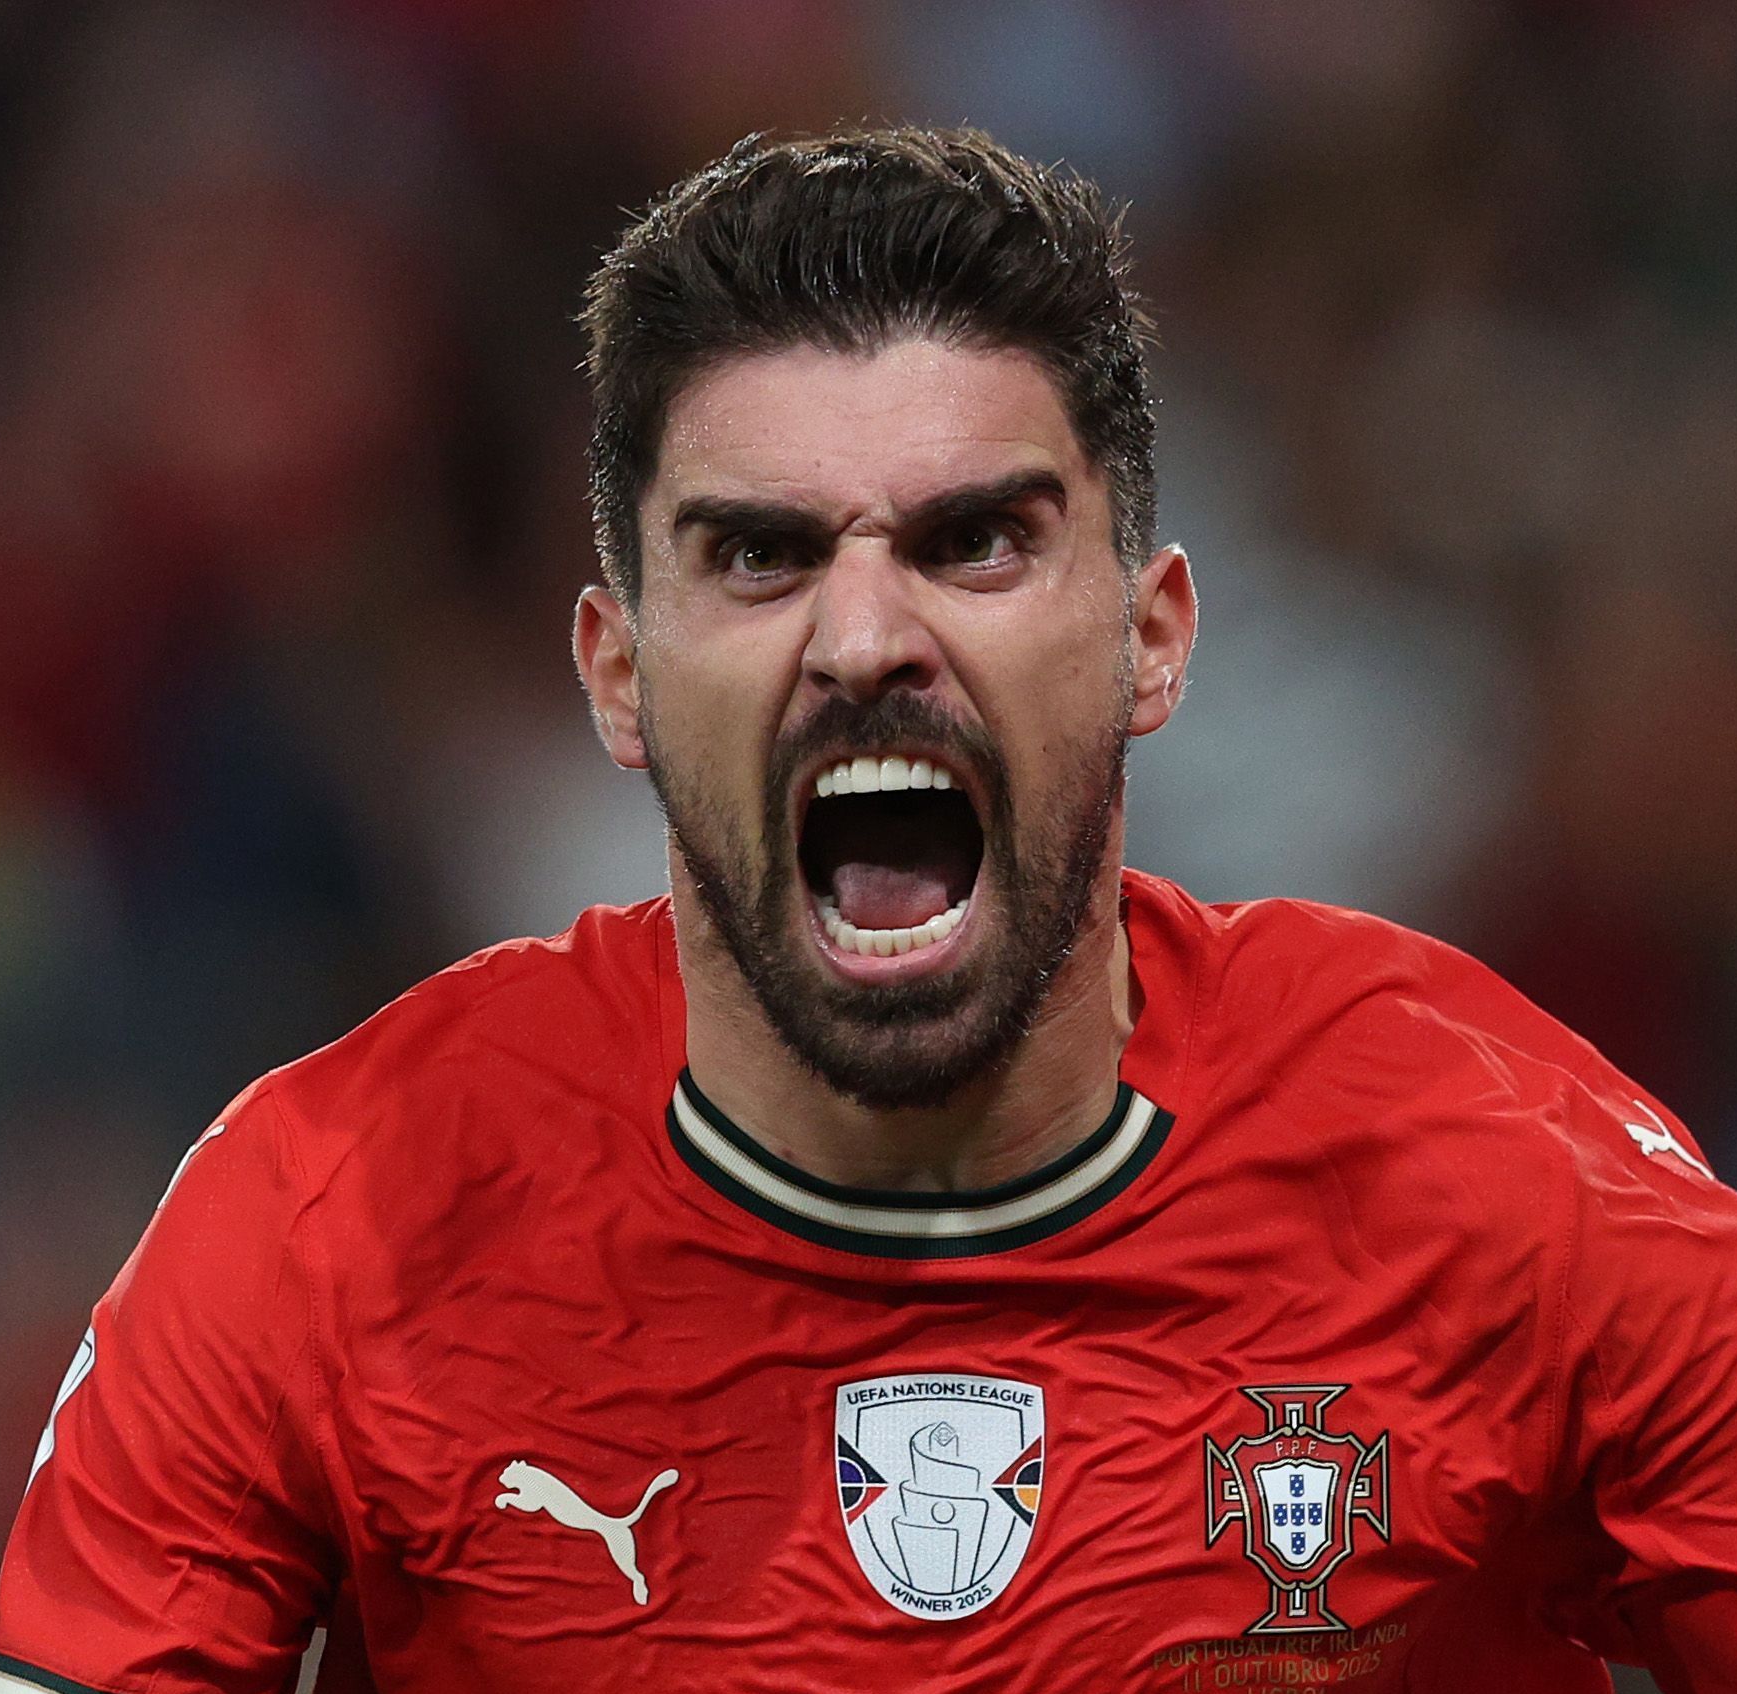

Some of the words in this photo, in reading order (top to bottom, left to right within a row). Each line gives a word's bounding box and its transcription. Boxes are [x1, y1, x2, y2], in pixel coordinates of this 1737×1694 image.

[846, 1387, 889, 1405] UEFA
[892, 1382, 965, 1397] NATIONS
[970, 1383, 1035, 1407] LEAGUE
[890, 1582, 952, 1612] WINNER
[957, 1585, 993, 1610] 2025
[1214, 1656, 1330, 1688] OUTUBRO
[1336, 1649, 1382, 1681] 2025
